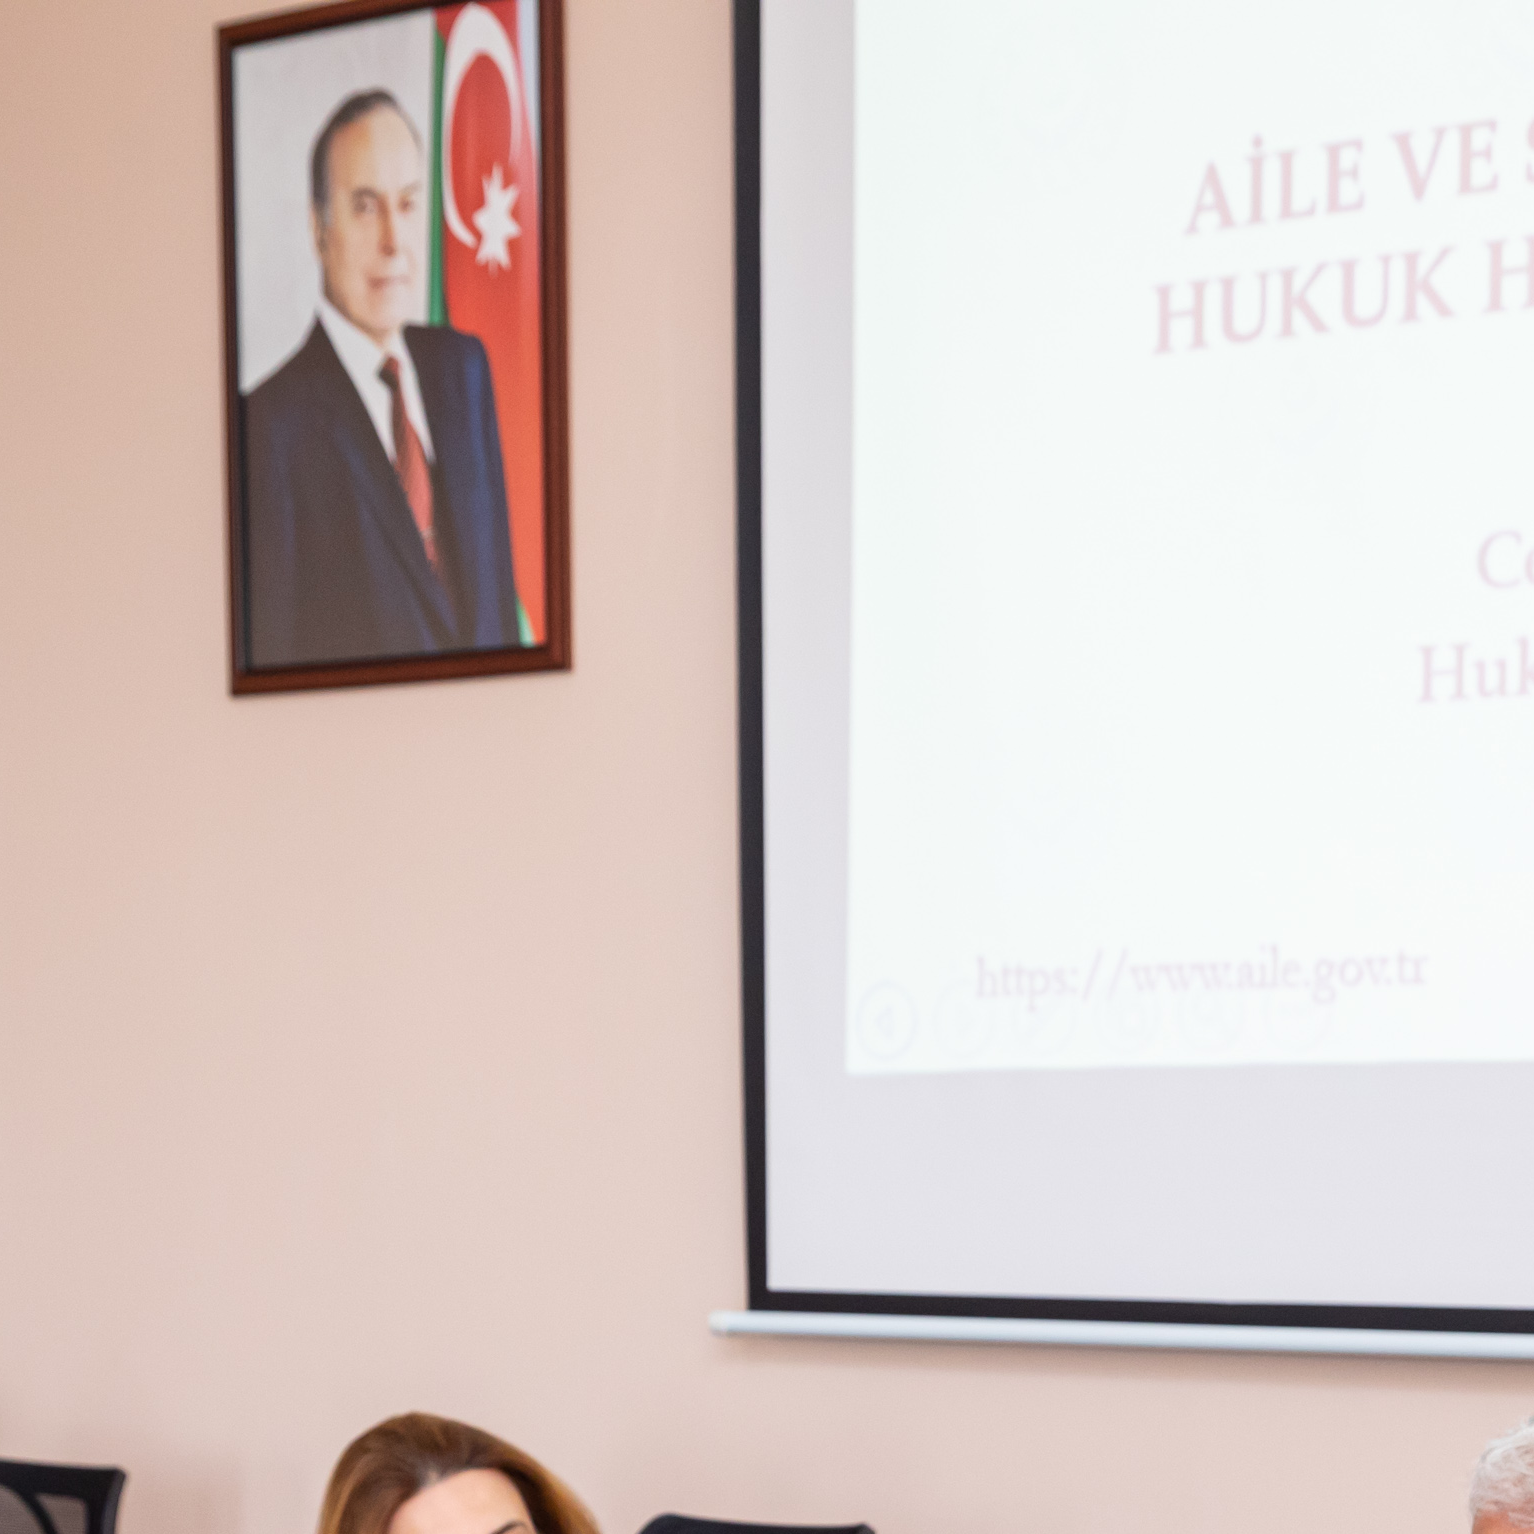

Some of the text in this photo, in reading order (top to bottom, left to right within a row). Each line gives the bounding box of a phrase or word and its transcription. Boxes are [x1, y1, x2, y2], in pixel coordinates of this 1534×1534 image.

[1184, 138, 1365, 236] AİLE
[1390, 118, 1499, 202] VE
[1153, 246, 1455, 355] HUKUK
[976, 944, 1428, 1013] https://www.aile.gov.tr
